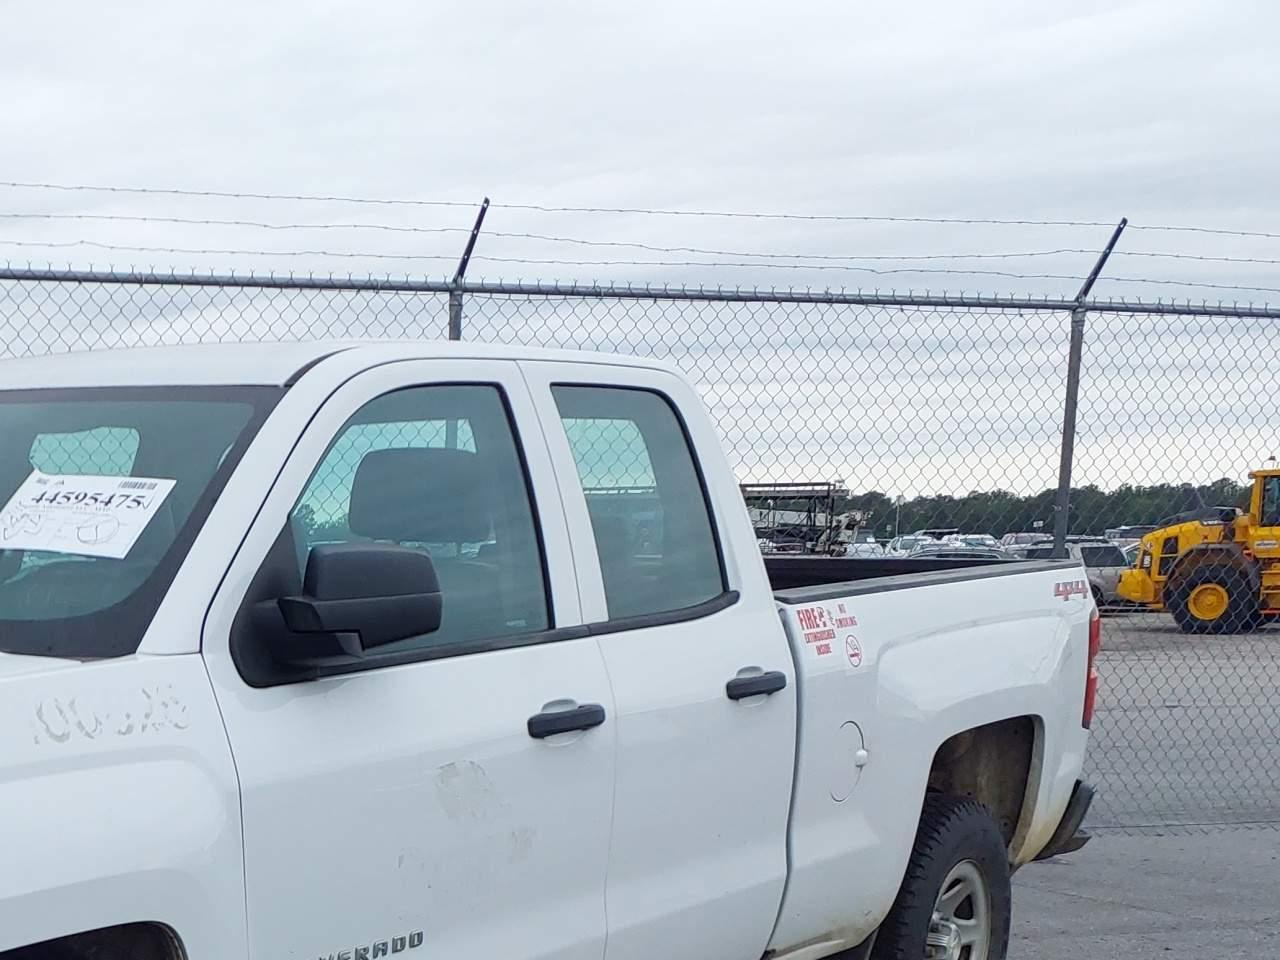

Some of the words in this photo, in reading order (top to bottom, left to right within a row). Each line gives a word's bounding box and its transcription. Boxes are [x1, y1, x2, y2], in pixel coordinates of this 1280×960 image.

[31, 490, 146, 509] 44595475
[796, 608, 820, 630] FIRE
[835, 616, 858, 628] SMOKING
